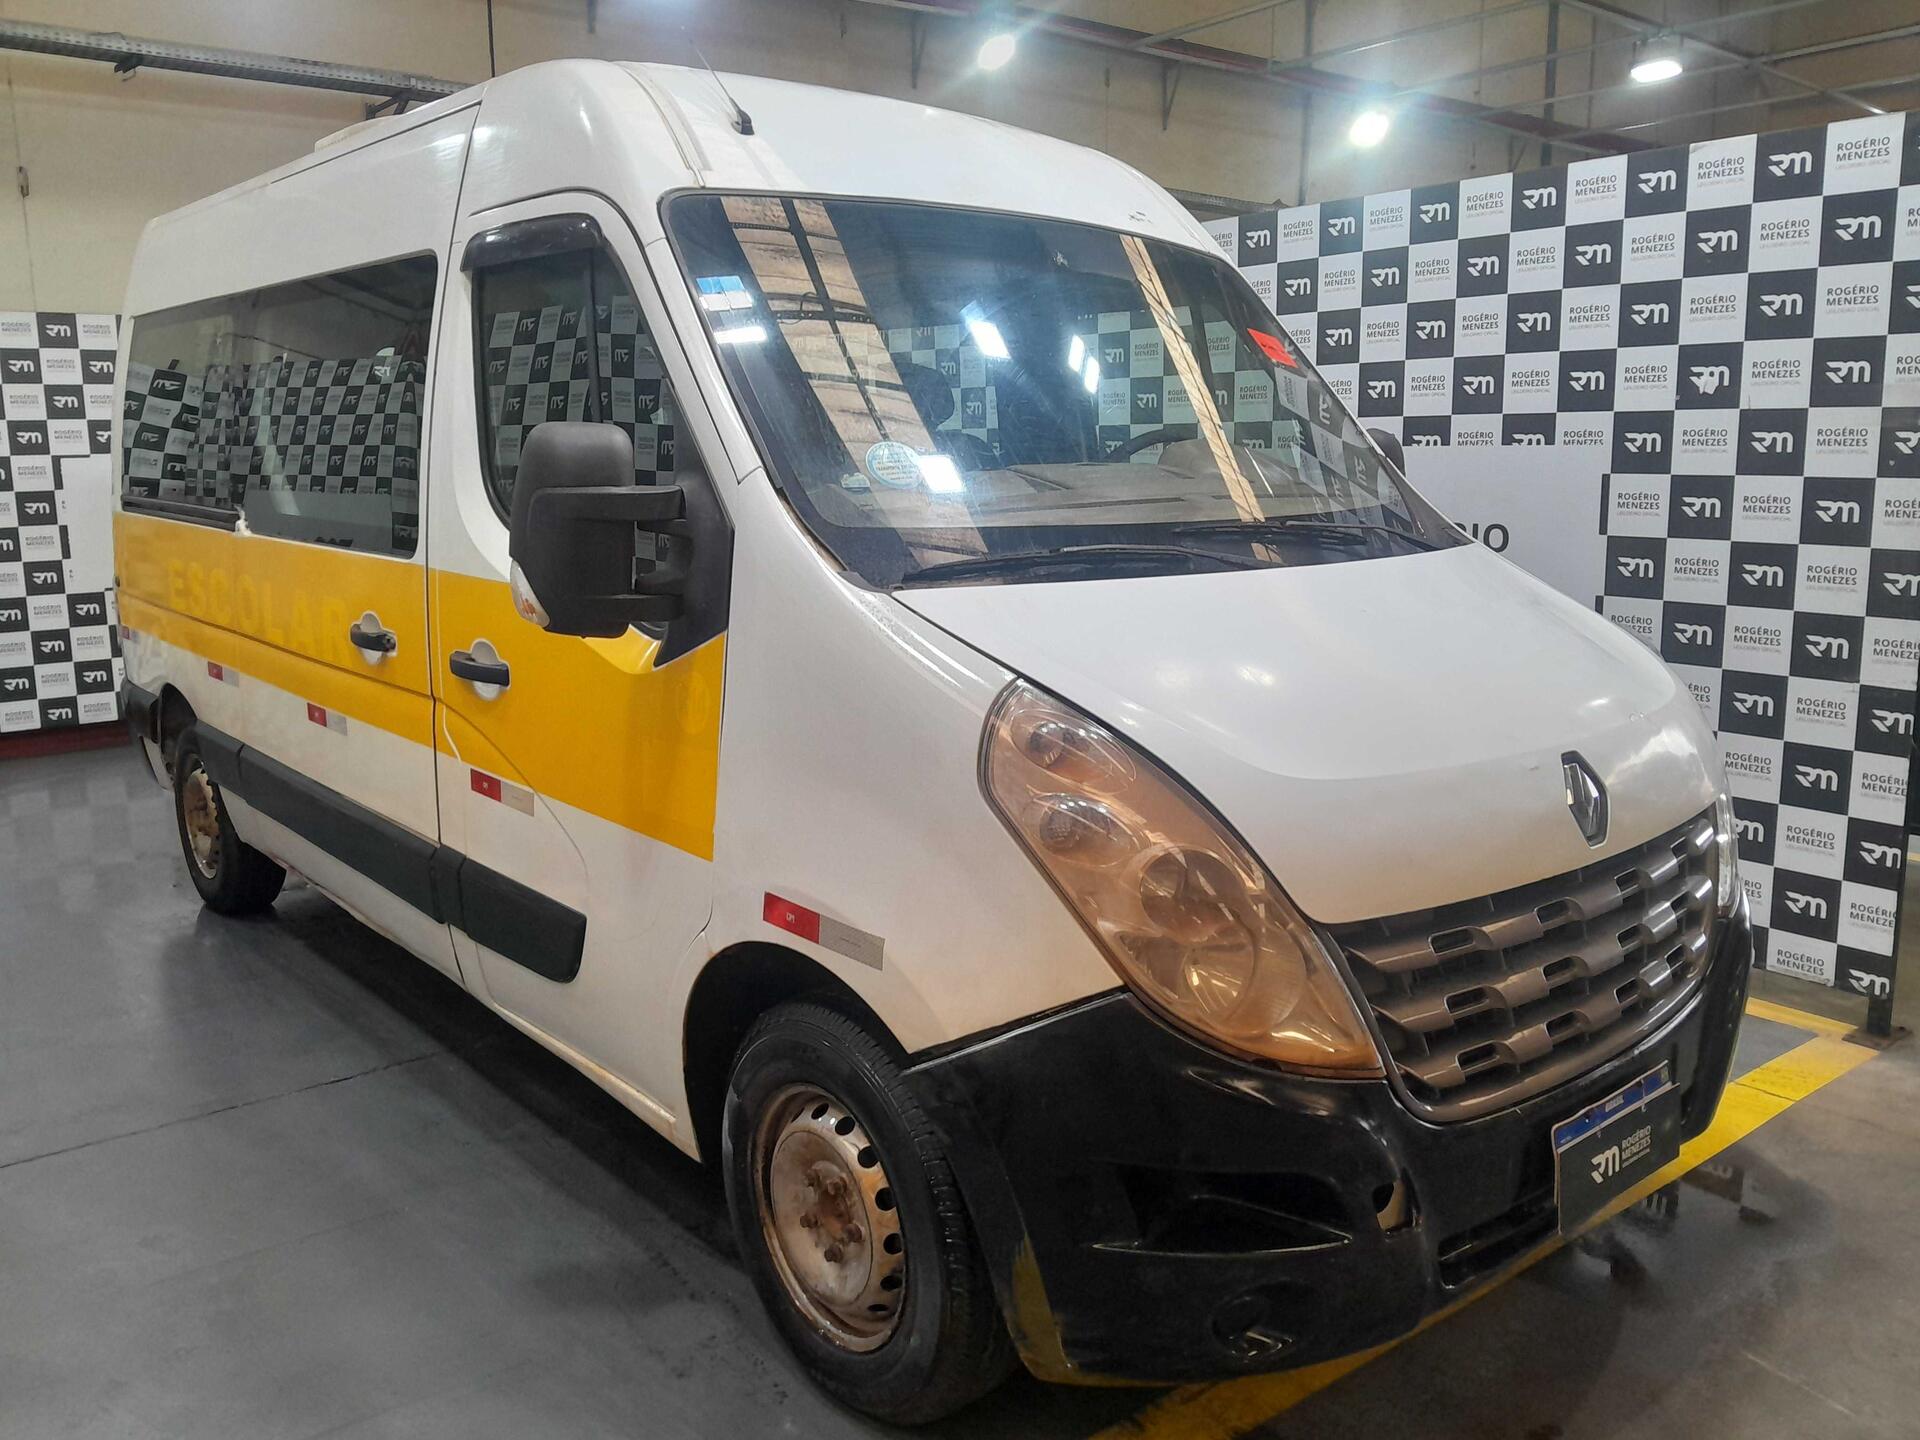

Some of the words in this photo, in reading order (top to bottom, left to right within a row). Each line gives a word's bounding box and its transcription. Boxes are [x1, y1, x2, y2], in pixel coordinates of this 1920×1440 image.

[1838, 137, 1890, 152] ROGÉRIO
[1837, 147, 1890, 162] MENEZES
[1698, 157, 1744, 170] ROGÉRIO
[1698, 166, 1744, 179] MENEZES
[1576, 175, 1616, 187] ROGÉRIO
[1576, 184, 1616, 196] MENEZES
[1467, 192, 1503, 203] ROGÉRIO
[1467, 200, 1503, 212] MENEZES
[1370, 206, 1403, 217] ROGÉRIO
[1284, 220, 1312, 230] ROGÉRIO
[1370, 214, 1403, 226] MENEZES
[1761, 219, 1809, 230] ROGÉRIO
[1214, 232, 1233, 241] GÉRIO
[1284, 228, 1313, 240] MENEZES
[1760, 229, 1809, 240] MENEZES
[1632, 234, 1675, 245] ROGÉRIO
[1517, 247, 1555, 257] ROGÉRIO
[1631, 242, 1674, 255] MENEZES
[1416, 259, 1449, 268] ROGÉRIO
[1517, 255, 1555, 266] MENEZES
[1325, 270, 1355, 279] ROGÉRIO
[1416, 266, 1449, 276] MENEZES
[1252, 280, 1270, 288] GÉRIO
[1324, 277, 1355, 289] MENEZES
[1827, 285, 1878, 296] ROGÉRIO
[1691, 295, 1736, 305] ROGÉRIO
[1827, 295, 1878, 306] MENEZES
[1570, 305, 1610, 314] ROGÉRIO
[1690, 304, 1736, 314] MENEZES
[1463, 313, 1498, 322] ROGÉRIO
[1570, 313, 1610, 322] MENEZES
[1367, 321, 1399, 330] ROGÉRIO
[1462, 321, 1498, 330] MENEZES
[1289, 329, 1310, 337] GÉRIO
[1367, 329, 1399, 340] MENEZES
[1134, 341, 1159, 350] ROGÉRIO
[1753, 360, 1800, 369] ROGÉRIO
[1512, 370, 1550, 378] ROGÉRIO
[1625, 366, 1667, 374] ROGÉRIO
[1752, 370, 1800, 378] MENEZES
[1412, 375, 1445, 383] ROGÉRIO
[1512, 379, 1550, 387] MENEZES
[1624, 374, 1667, 383] MENEZES
[1240, 384, 1268, 393] ROGÉRIO
[1330, 380, 1352, 388] GÉRIO
[1411, 383, 1445, 391] MENEZES
[1240, 391, 1268, 400] MENEZES
[1564, 430, 1603, 438] ROGÉRIO
[1683, 429, 1727, 437] ROGÉRIO
[1818, 428, 1868, 437] ROGÉRIO
[1682, 438, 1727, 446] MENEZES
[1817, 438, 1867, 446] MENEZES
[1618, 492, 1660, 501] ROGÉRIO
[1744, 496, 1790, 504] ROGÉRIO
[1618, 502, 1659, 510] MENEZES
[1886, 500, 1920, 508] ROGÉ
[1743, 505, 1790, 514] MENEZES
[1675, 558, 1719, 567] ROGÉRIO
[1674, 567, 1718, 576] MENEZES
[1808, 566, 1857, 576] ROGÉRIO
[1807, 575, 1856, 585] MENEZES
[1611, 615, 1652, 625] ROGÉRIO
[1735, 626, 1781, 637] ROGÉRIO
[1734, 635, 1780, 646] MENEZES
[1873, 648, 1919, 660] MENEZE
[1689, 683, 1710, 694] ÉRIO
[1797, 698, 1846, 710] ROGÉRIO
[1796, 707, 1846, 720] MENEZES
[1726, 752, 1771, 765] ROGÉRIO
[1725, 760, 1771, 775] MENEZES
[1862, 782, 1907, 796] MENEZE
[1787, 826, 1834, 840] ROGÉRIO
[1786, 834, 1834, 850] MENEZES
[1850, 912, 1894, 928] MENEZE
[1778, 950, 1824, 966] ROGÉRIO
[1776, 958, 1824, 976] MENEZES
